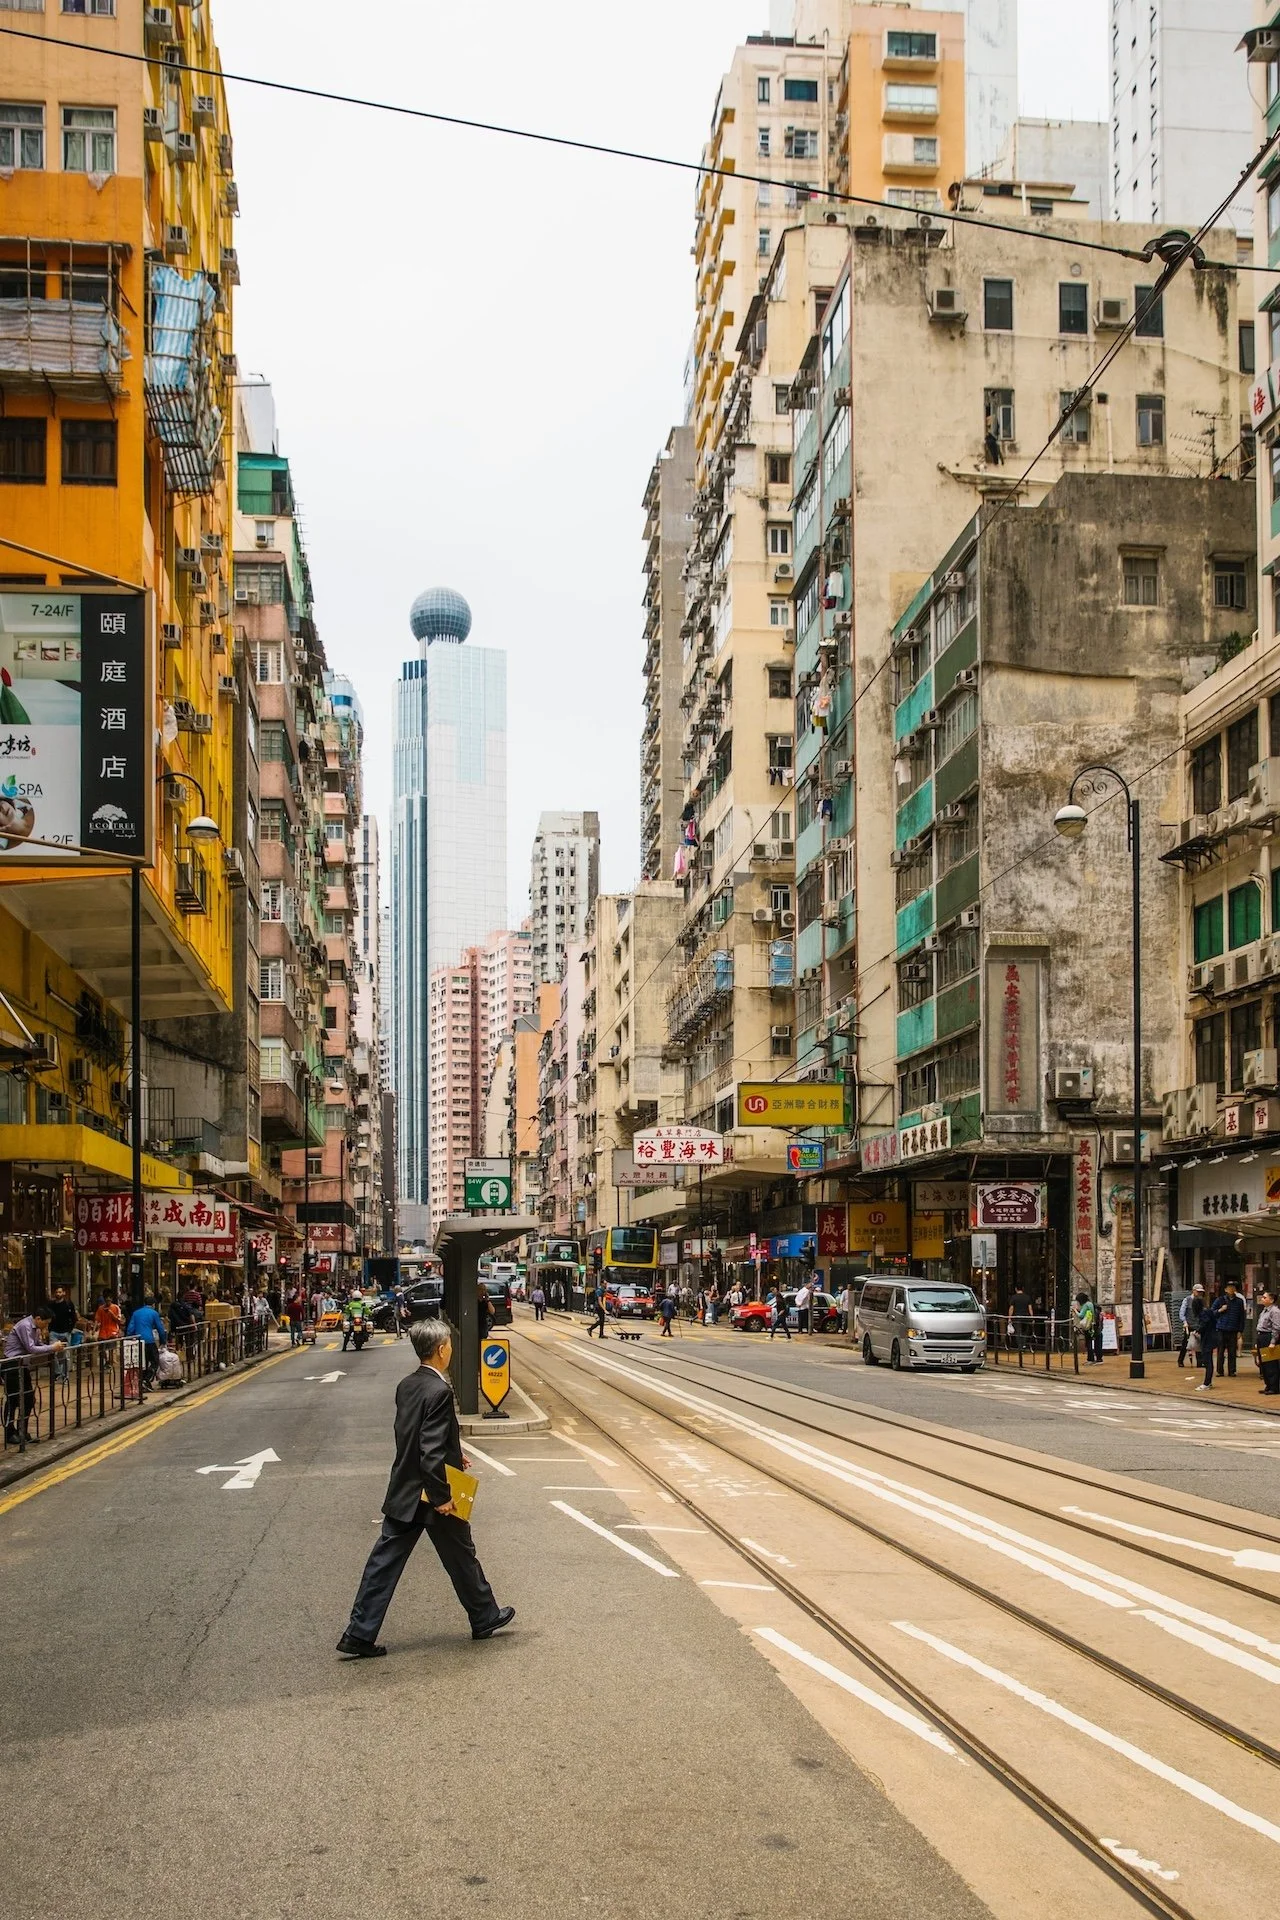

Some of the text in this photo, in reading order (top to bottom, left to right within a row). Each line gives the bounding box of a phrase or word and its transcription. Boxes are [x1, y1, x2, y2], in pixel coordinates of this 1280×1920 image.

[31, 604, 74, 617] 7-24/F
[100, 612, 127, 779] 頤庭酒店
[18, 783, 43, 796] SPA
[637, 1139, 719, 1159] 裕豐海味
